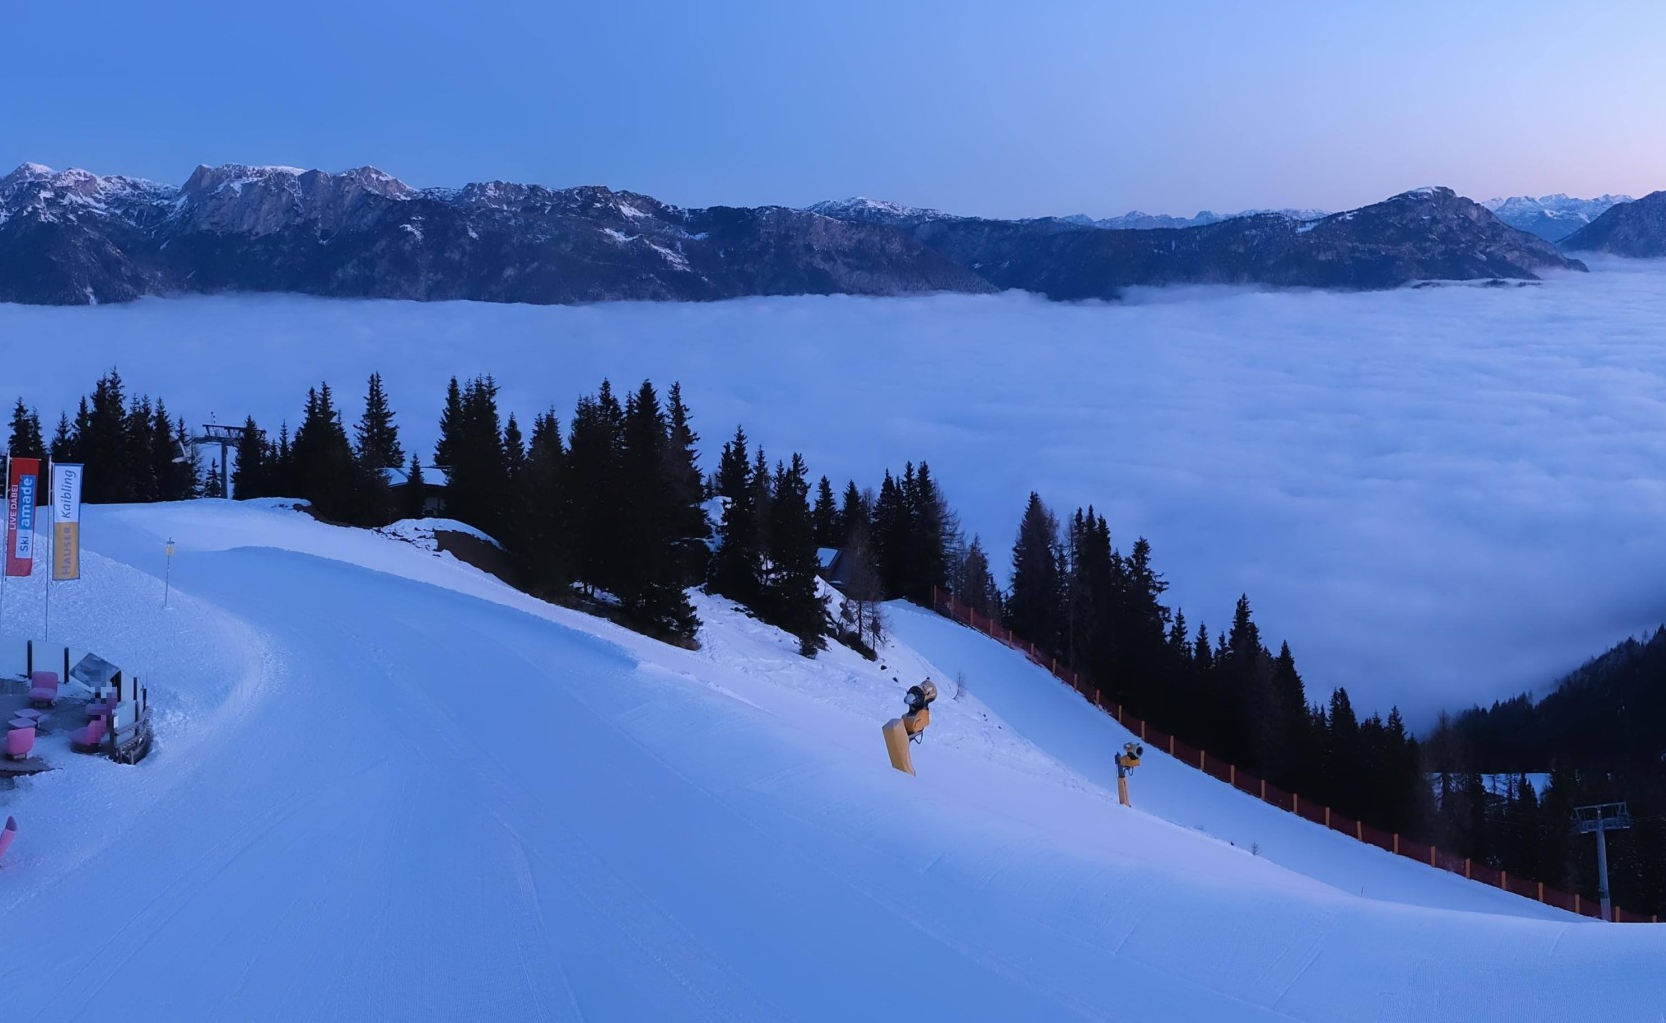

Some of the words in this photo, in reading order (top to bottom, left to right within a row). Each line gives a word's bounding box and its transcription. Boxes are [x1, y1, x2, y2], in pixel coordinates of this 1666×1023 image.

[10, 484, 19, 509] DABEI
[61, 469, 77, 519] Kaibling
[9, 511, 17, 530] LIVE
[19, 536, 29, 552] Ski
[61, 527, 72, 575] HAUSER
